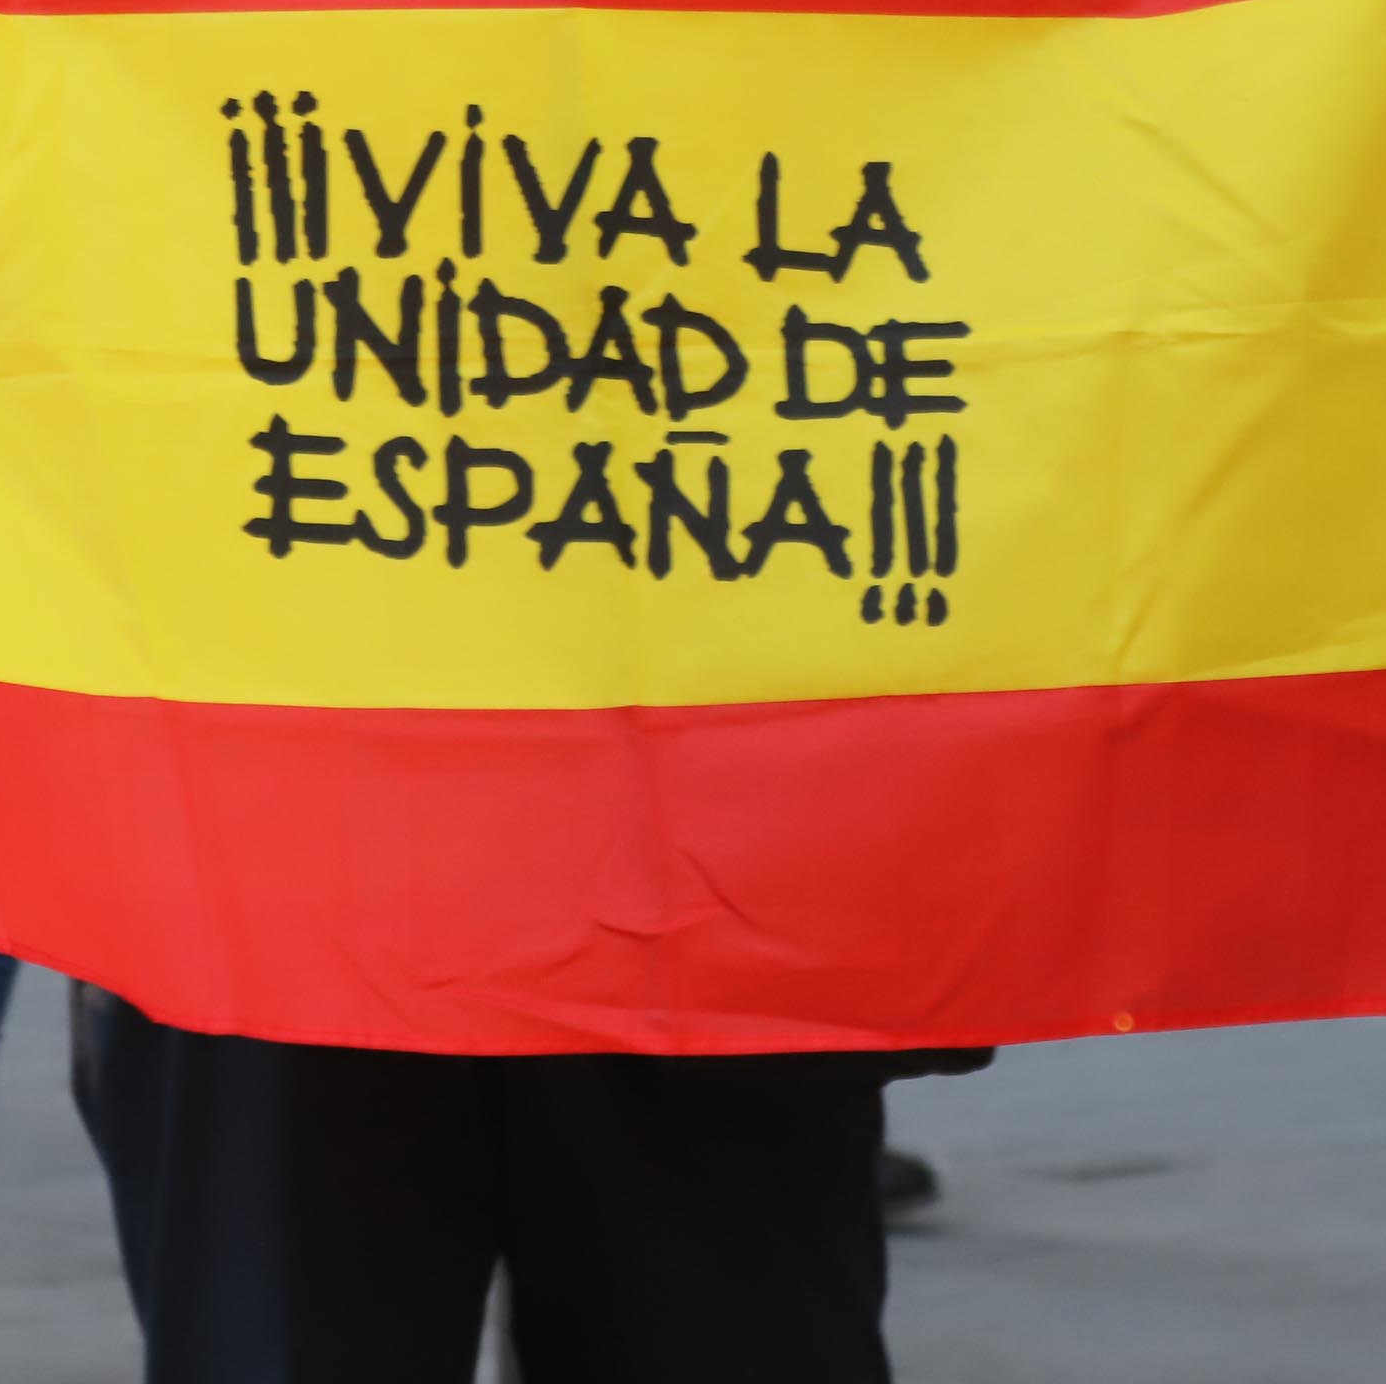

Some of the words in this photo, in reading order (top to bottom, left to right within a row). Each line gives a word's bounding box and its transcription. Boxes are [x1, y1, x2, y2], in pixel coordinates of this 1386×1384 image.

[742, 151, 930, 284] LA
[774, 304, 971, 430] DE
[243, 414, 959, 627] ESPAÑA!!!
